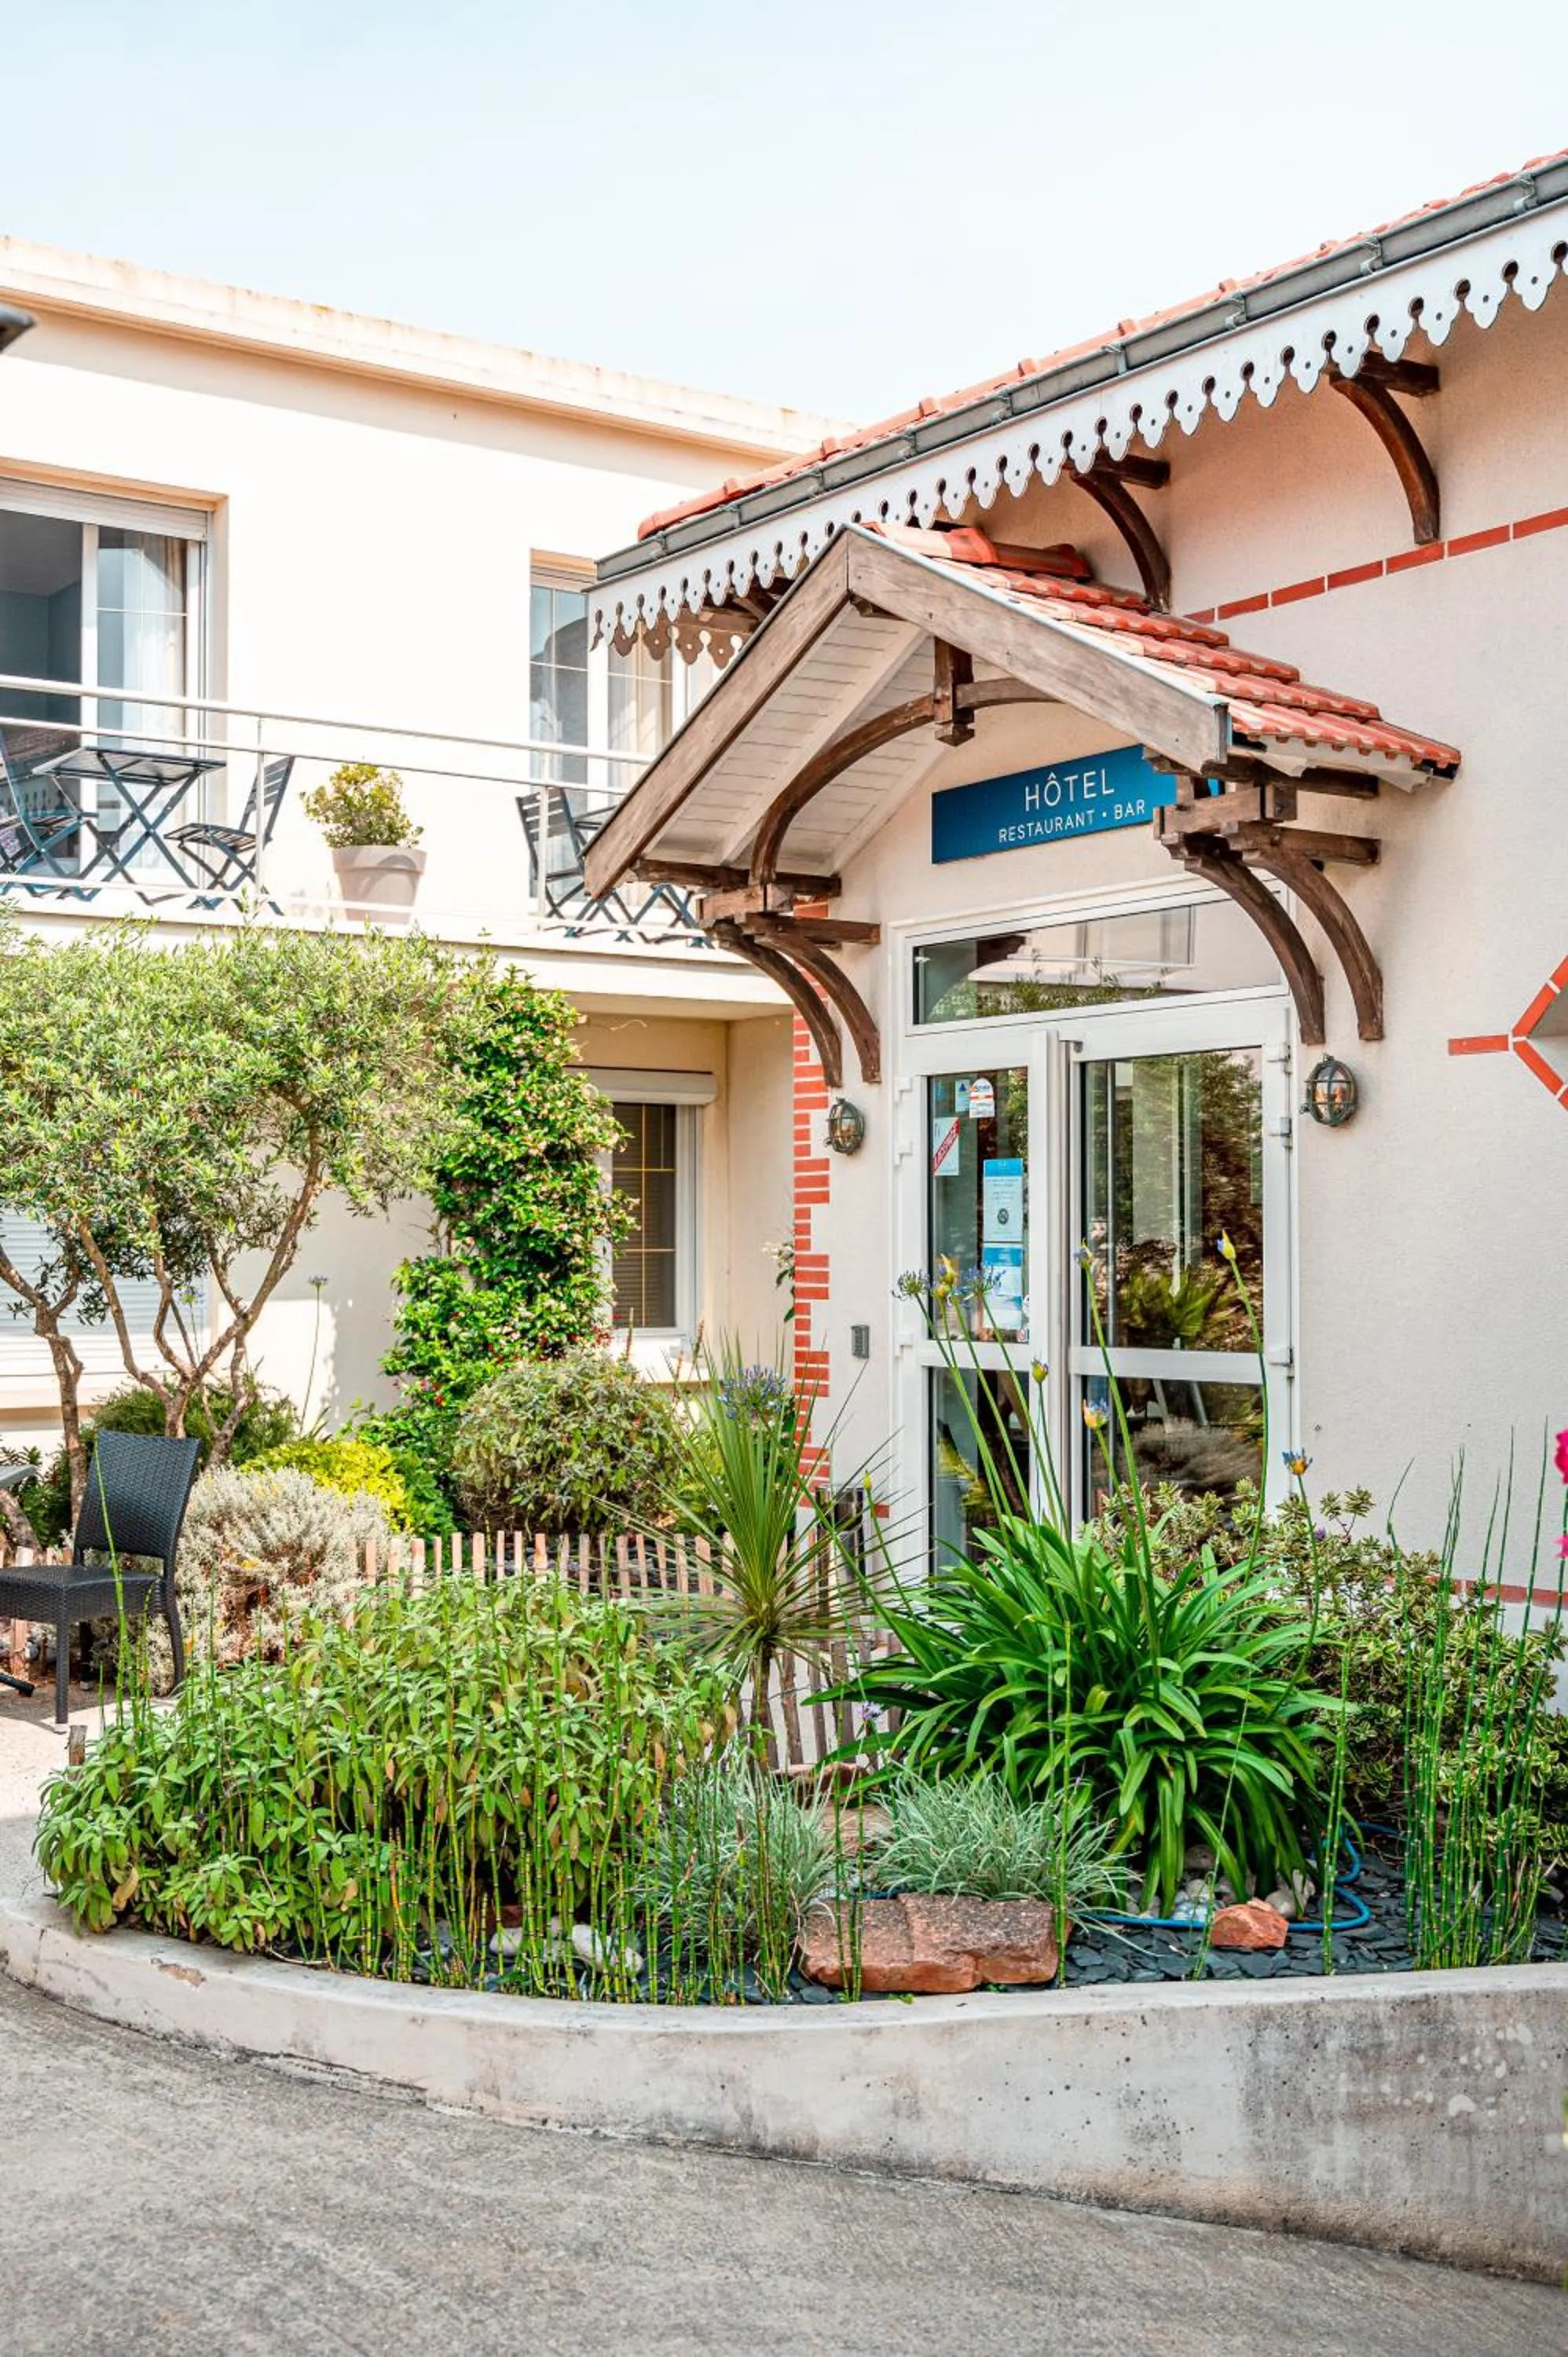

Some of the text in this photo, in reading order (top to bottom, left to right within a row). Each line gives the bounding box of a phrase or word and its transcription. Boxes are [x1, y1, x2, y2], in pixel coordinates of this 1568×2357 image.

[1025, 768, 1114, 811] HÔTEL
[998, 799, 1145, 842] RESTAURANT BAR
